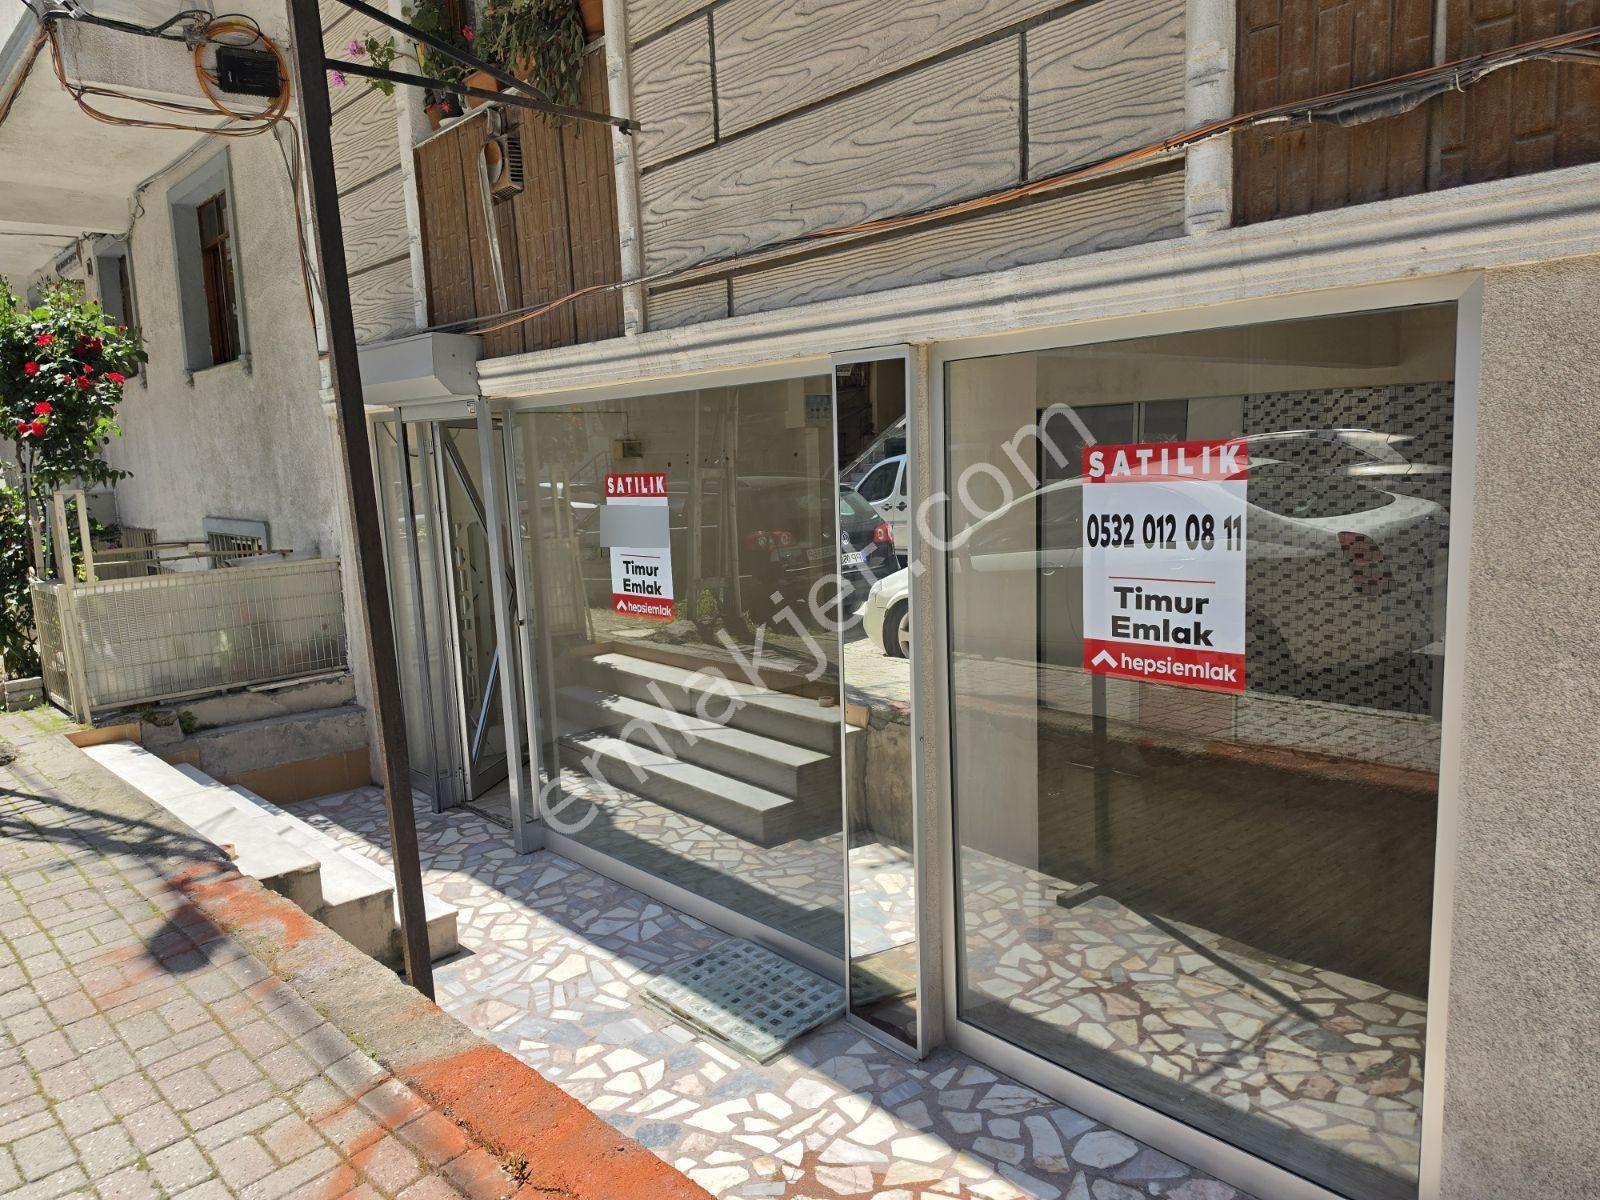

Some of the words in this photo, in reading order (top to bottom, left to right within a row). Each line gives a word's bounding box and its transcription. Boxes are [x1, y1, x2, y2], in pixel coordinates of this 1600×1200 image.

[1088, 444, 1241, 478] SATILIK
[607, 476, 665, 494] SATILIK
[1086, 513, 1135, 549] 0532
[1142, 513, 1177, 550] 012
[1185, 514, 1215, 551] 08
[1223, 515, 1242, 552] 11
[622, 560, 659, 577] Timur
[622, 578, 662, 596] Emlak
[1113, 586, 1210, 615] Timur
[627, 601, 672, 617] hepsiemlak
[1111, 615, 1214, 647] Emlak
[1121, 652, 1237, 683] hepsiemlak
